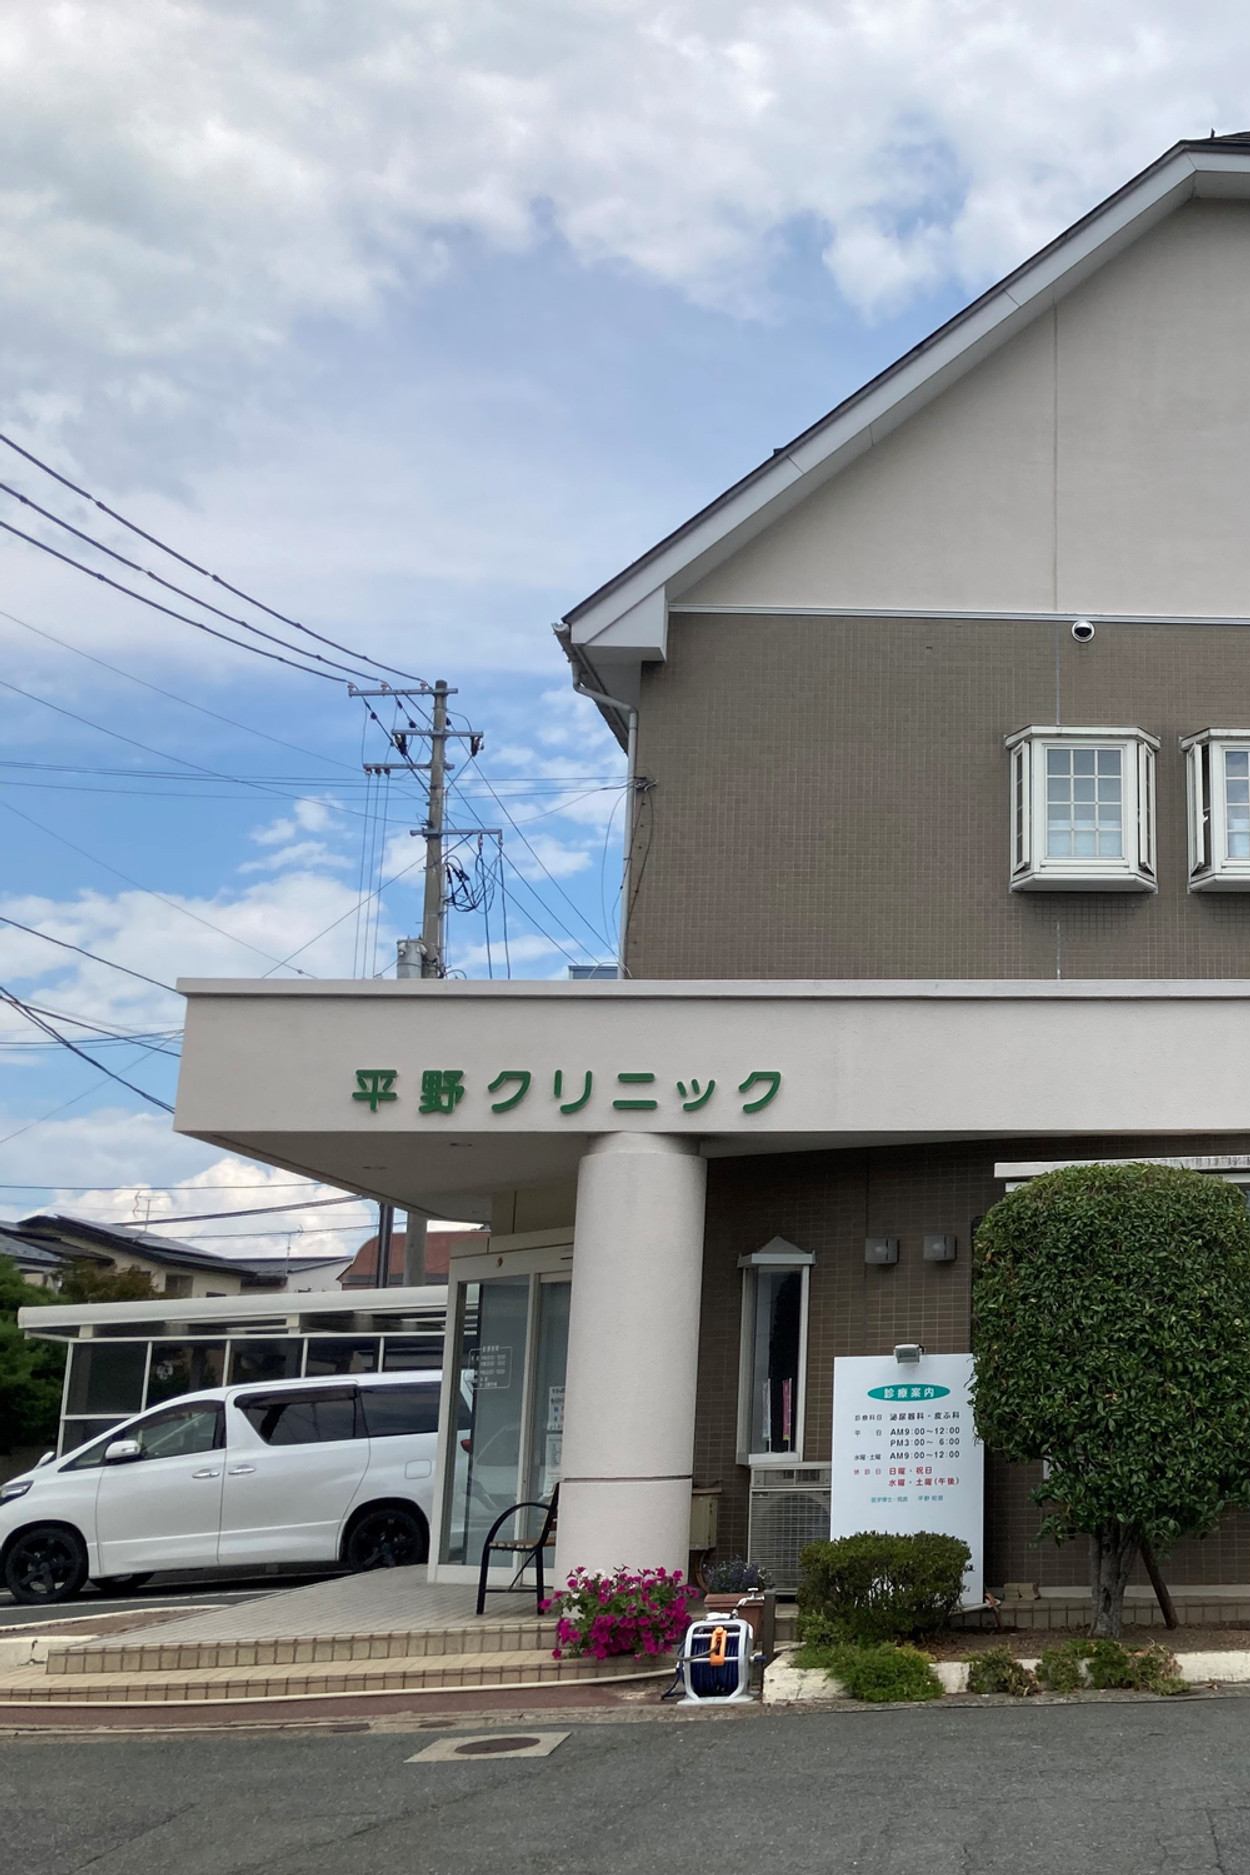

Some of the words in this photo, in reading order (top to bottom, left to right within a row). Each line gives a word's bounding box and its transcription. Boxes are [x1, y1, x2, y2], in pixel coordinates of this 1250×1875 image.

[352, 1069, 782, 1114] 平野クリニック
[883, 1387, 935, 1399] 診療案内
